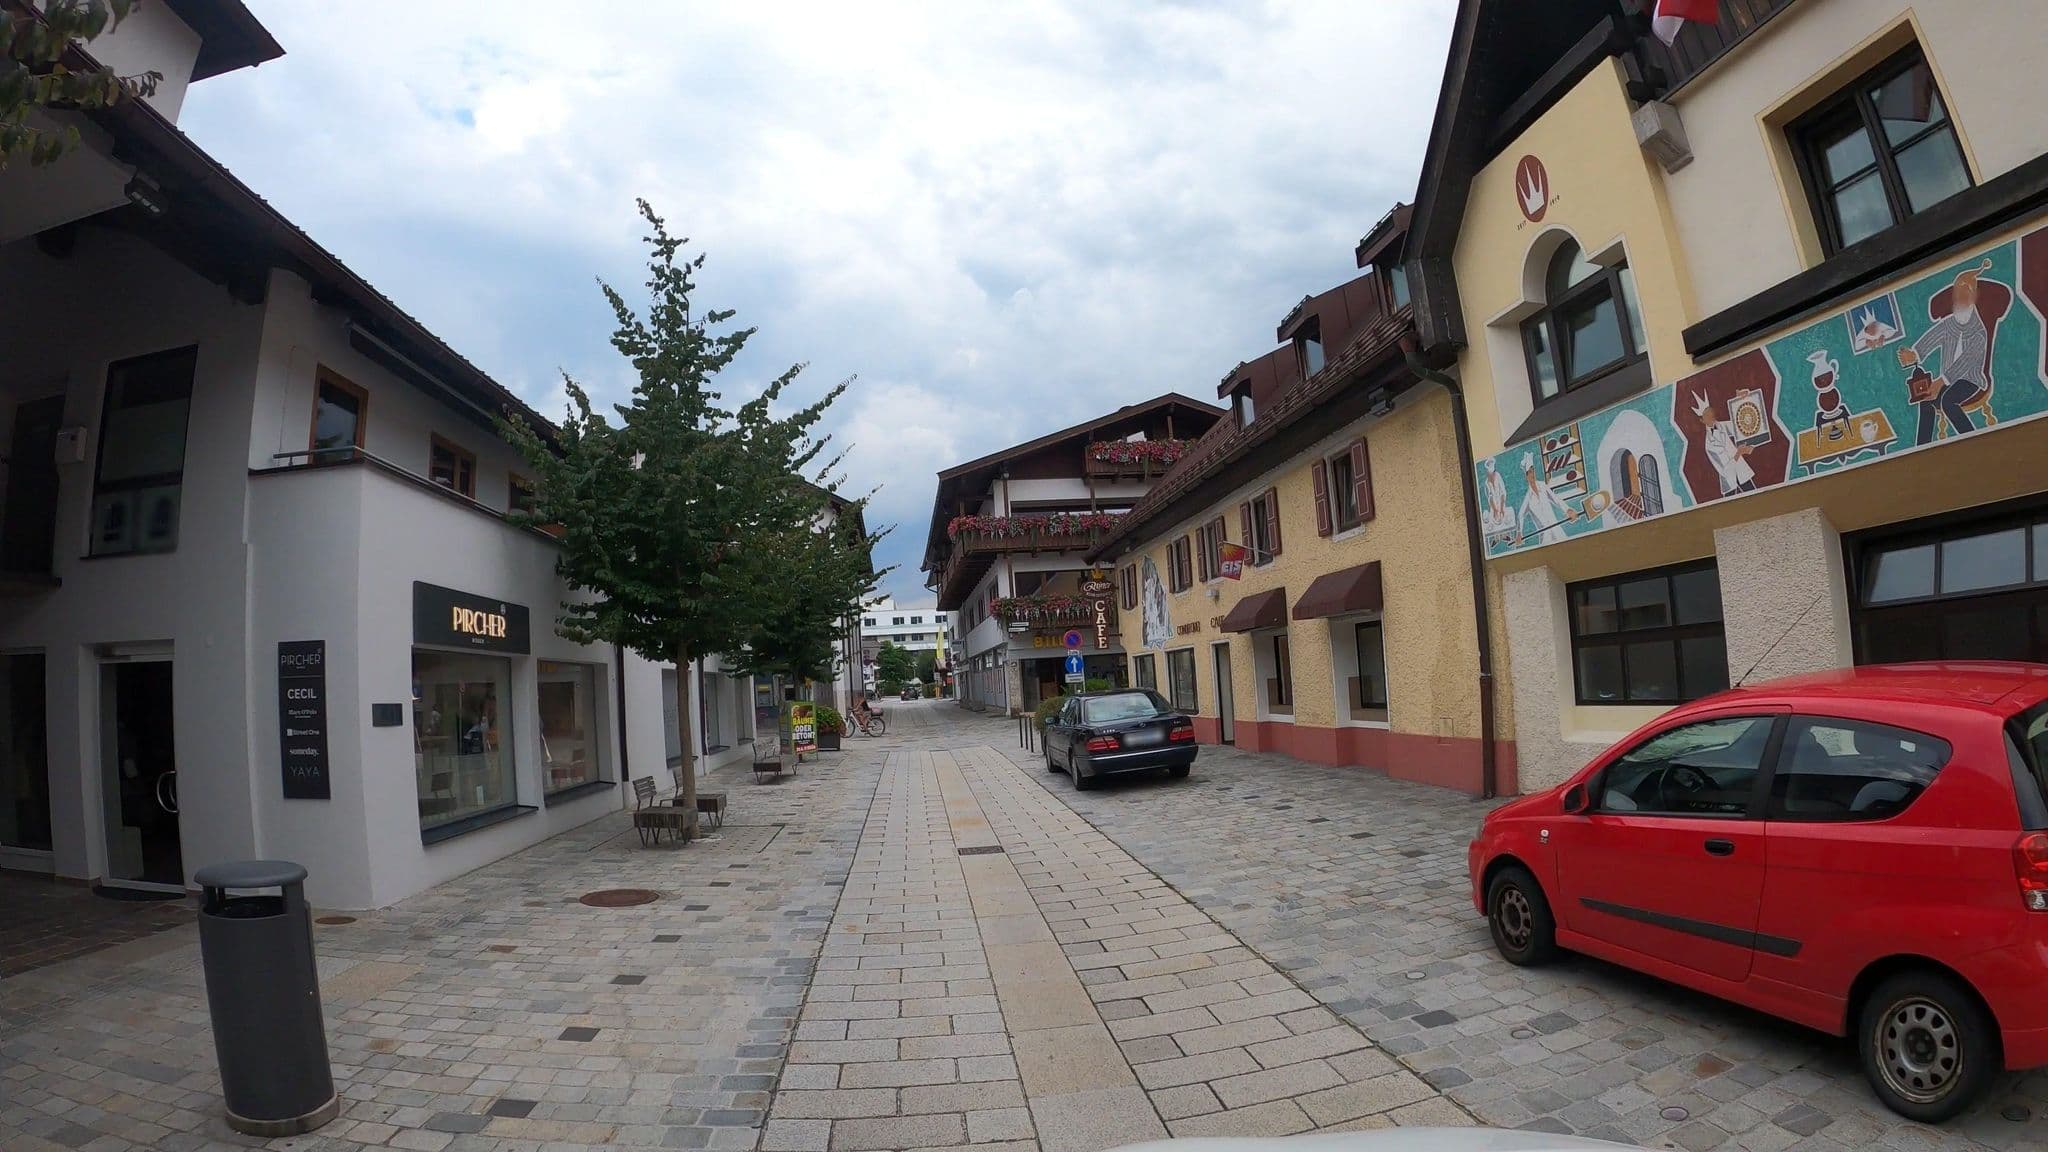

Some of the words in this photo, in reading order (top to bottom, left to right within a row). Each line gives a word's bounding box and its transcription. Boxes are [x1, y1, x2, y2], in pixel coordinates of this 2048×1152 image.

[453, 606, 506, 638] PIRCHER
[1095, 600, 1108, 649] CAFE
[281, 653, 321, 666] PIRCHER
[287, 688, 317, 699] CECIL
[795, 725, 812, 733] ODER
[291, 766, 320, 777] YAYA
